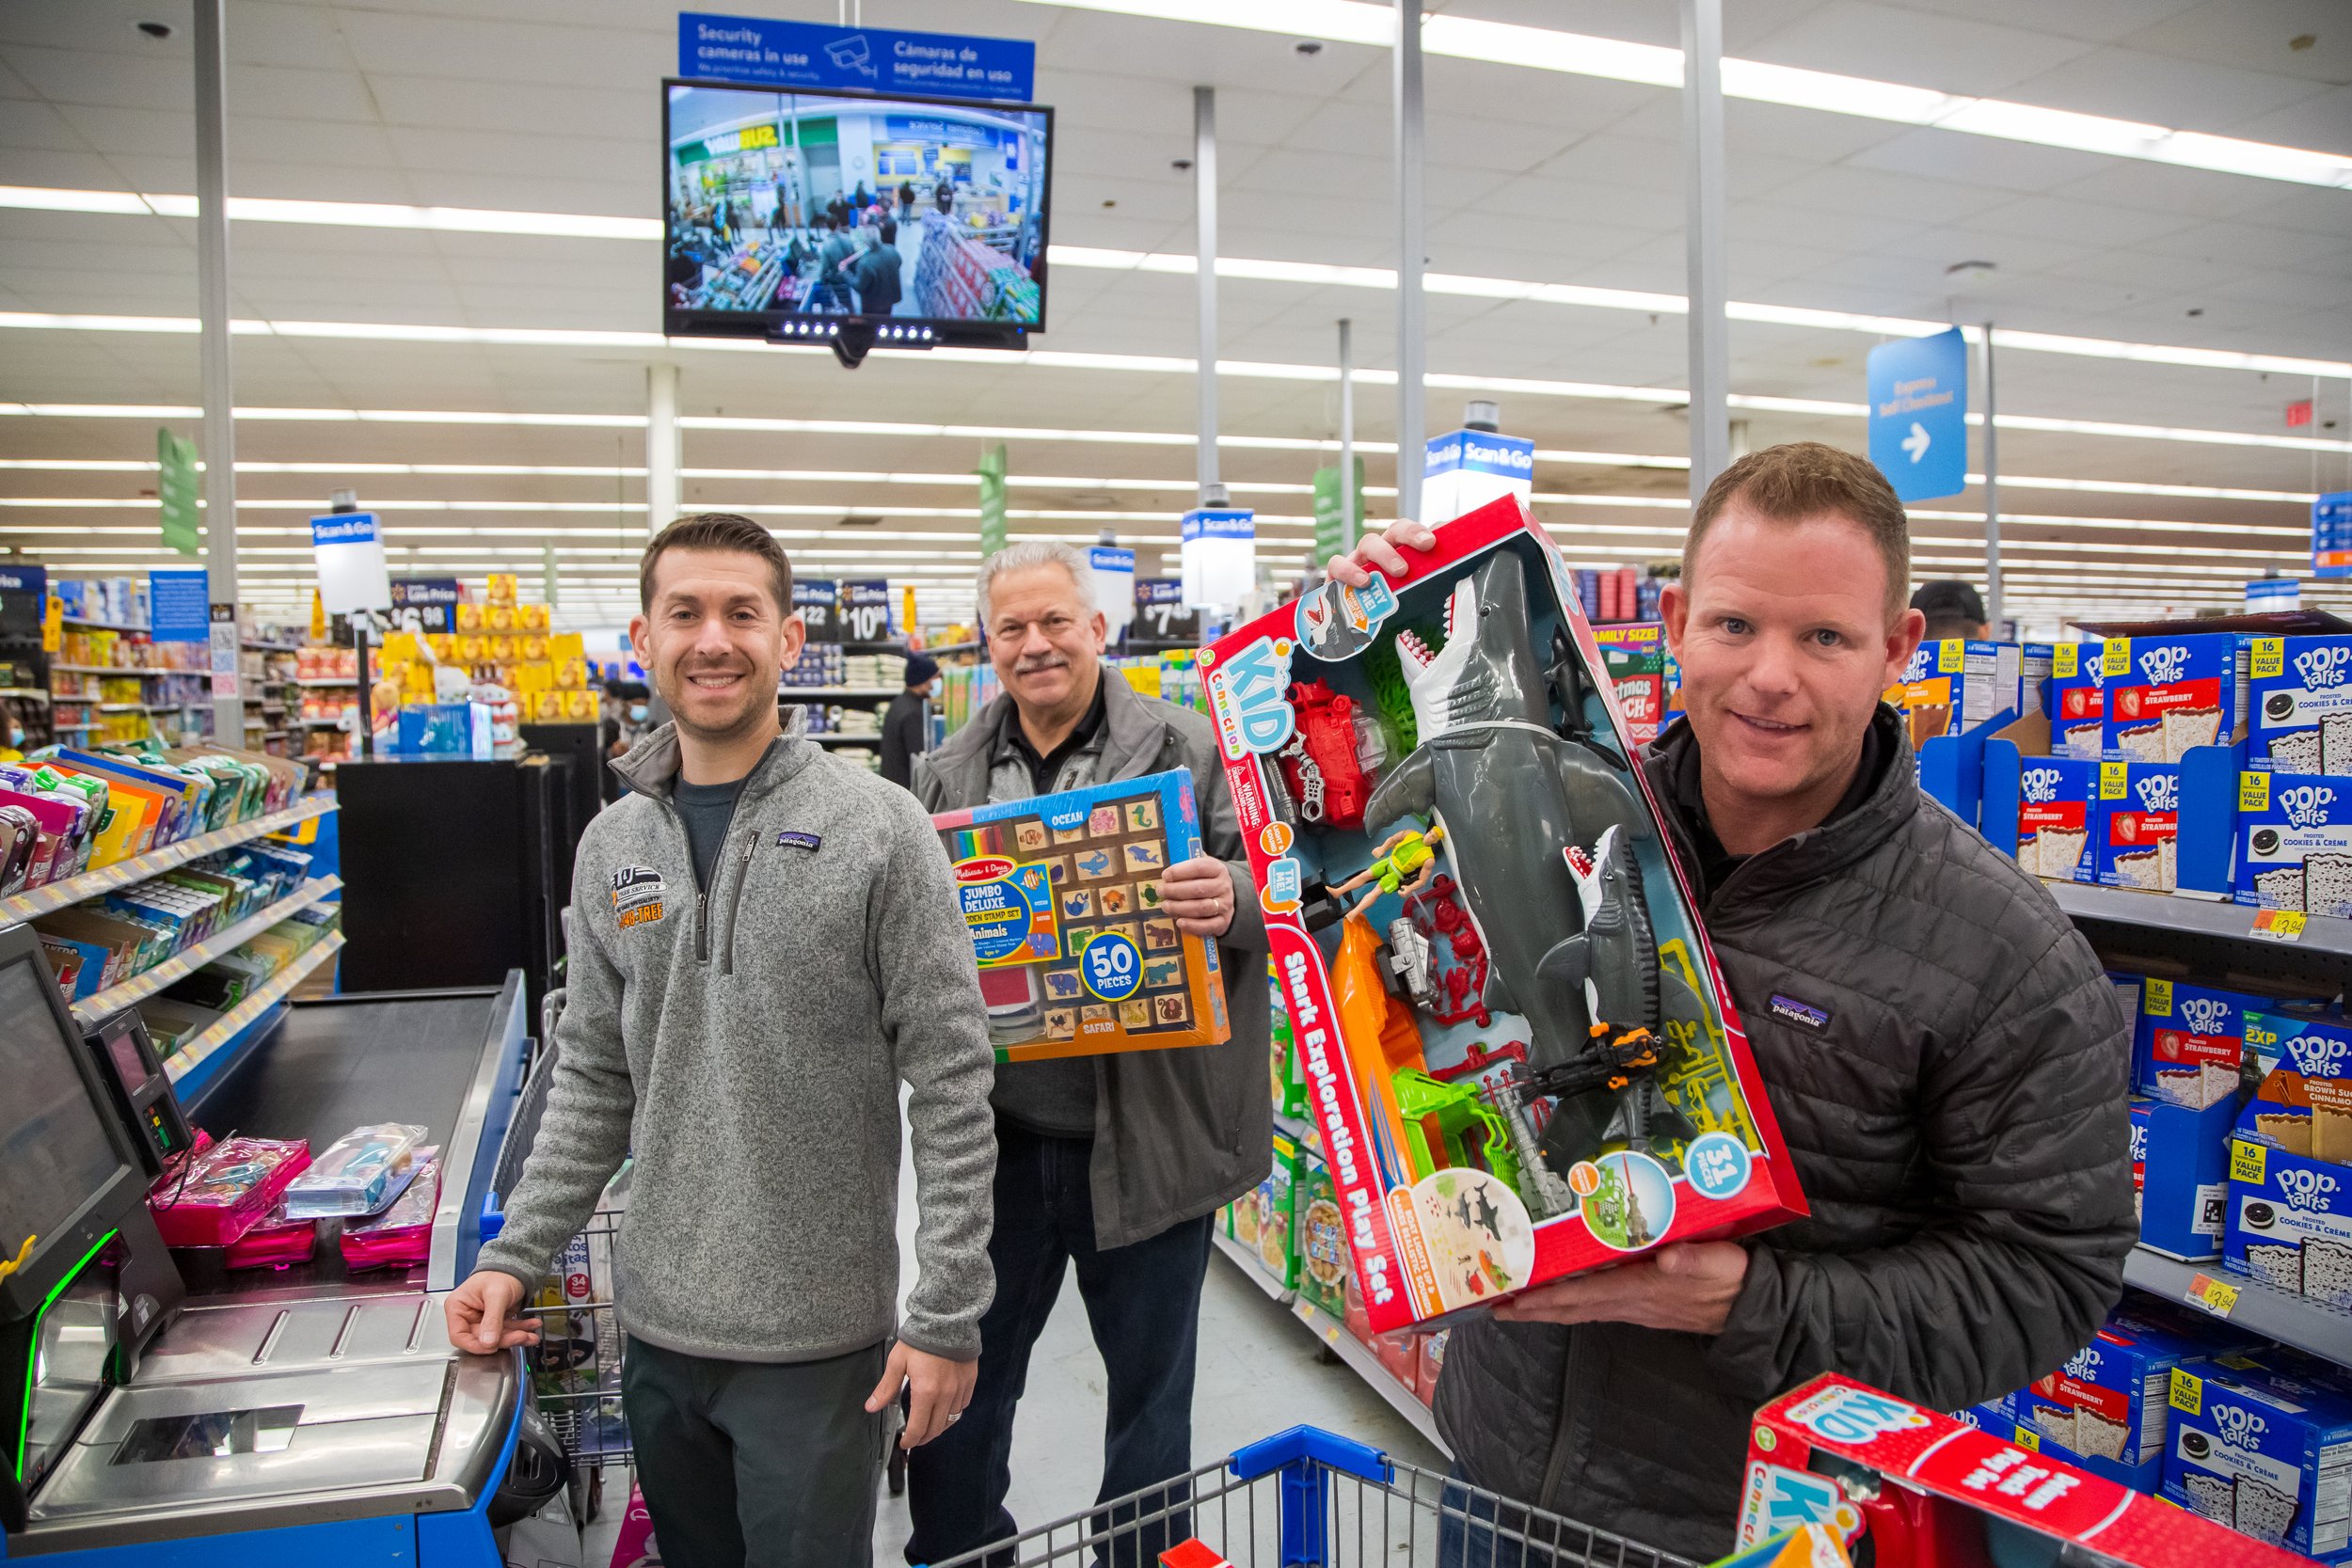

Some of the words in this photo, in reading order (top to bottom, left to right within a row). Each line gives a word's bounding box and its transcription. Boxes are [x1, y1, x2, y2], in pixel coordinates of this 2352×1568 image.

[697, 24, 762, 46] Security
[697, 45, 761, 62] cameras
[765, 48, 779, 63] in
[783, 52, 808, 66] use
[894, 40, 955, 61] Cámaras
[960, 47, 977, 62] de
[894, 62, 963, 78] seguridad
[966, 68, 984, 80] en
[988, 70, 1012, 83] uso
[1465, 442, 1532, 468] Scan&Go
[1369, 580, 1388, 604] TRY
[1593, 629, 1627, 642] AMILY
[1628, 627, 1659, 641] SIZE!
[2112, 642, 2122, 651] 16
[2263, 642, 2274, 651] 16
[2148, 666, 2184, 687] tarts
[2303, 669, 2345, 689] tarts
[1227, 642, 1288, 747] KID
[2145, 693, 2193, 705] STRAWBERRY
[2298, 699, 2329, 708] COOKIES
[2109, 767, 2119, 775] 16
[2249, 776, 2261, 785] 16
[2026, 787, 2057, 803] tarts
[2243, 791, 2265, 800] VALUE
[2244, 799, 2264, 807] PACK
[1241, 781, 1261, 828] WARNING:
[1051, 811, 1084, 826] OCEAN
[2288, 808, 2328, 828] tarts
[1265, 829, 1277, 852] SOUND
[1272, 824, 1282, 844] LIGHT
[779, 837, 814, 848] patagonia
[1275, 871, 1285, 892] ME!
[1285, 868, 1295, 891] TRY
[964, 885, 1002, 900] JUMBO
[964, 896, 1006, 912] DELUXE
[984, 911, 1006, 922] STAMP
[1008, 909, 1020, 918] SET
[969, 924, 1009, 940] Animals
[1090, 942, 1133, 977] 50
[1097, 974, 1132, 990] PIECES
[2154, 984, 2164, 992] 16
[2149, 997, 2169, 1006] VALUE
[2149, 1004, 2168, 1012] PACK
[1772, 1006, 1820, 1027] patagonia
[1083, 1022, 1115, 1035] SAFARI
[2188, 1019, 2224, 1035] tarts
[2245, 1029, 2277, 1046] 2XP
[2185, 1043, 2232, 1056] STRAWBERRY
[2296, 1058, 2342, 1077] tarts
[2304, 1084, 2336, 1095] BROWN
[1284, 951, 1319, 1029] Shark
[1304, 1028, 1359, 1184] Exploration
[1347, 1191, 1377, 1250] Play
[1365, 1255, 1394, 1306] Set
[2243, 1147, 2256, 1158] 16
[1695, 1151, 1715, 1188] PIECES
[1706, 1144, 1738, 1185] 31
[2235, 1160, 2262, 1173] VALUE
[2236, 1168, 2259, 1180] PACK
[2285, 1192, 2330, 1212] tarts
[2280, 1216, 2312, 1230] COOKIES
[2324, 1226, 2350, 1238] CRÈME
[2302, 1215, 2325, 1226] FROSTED
[572, 1276, 586, 1286] 34
[2063, 1362, 2097, 1382] tarts
[2181, 1375, 2193, 1388] 16
[2059, 1383, 2103, 1406] STRAWBERRY
[2173, 1387, 2199, 1403] VALUE
[2174, 1396, 2196, 1411] PACK
[1813, 1394, 1907, 1439] KID
[2022, 1433, 2032, 1445] 16
[2219, 1426, 2261, 1450] tarts
[2214, 1449, 2244, 1466] COOKIES
[2254, 1465, 2279, 1481] CRÈME
[2234, 1452, 2255, 1465] FROSTED
